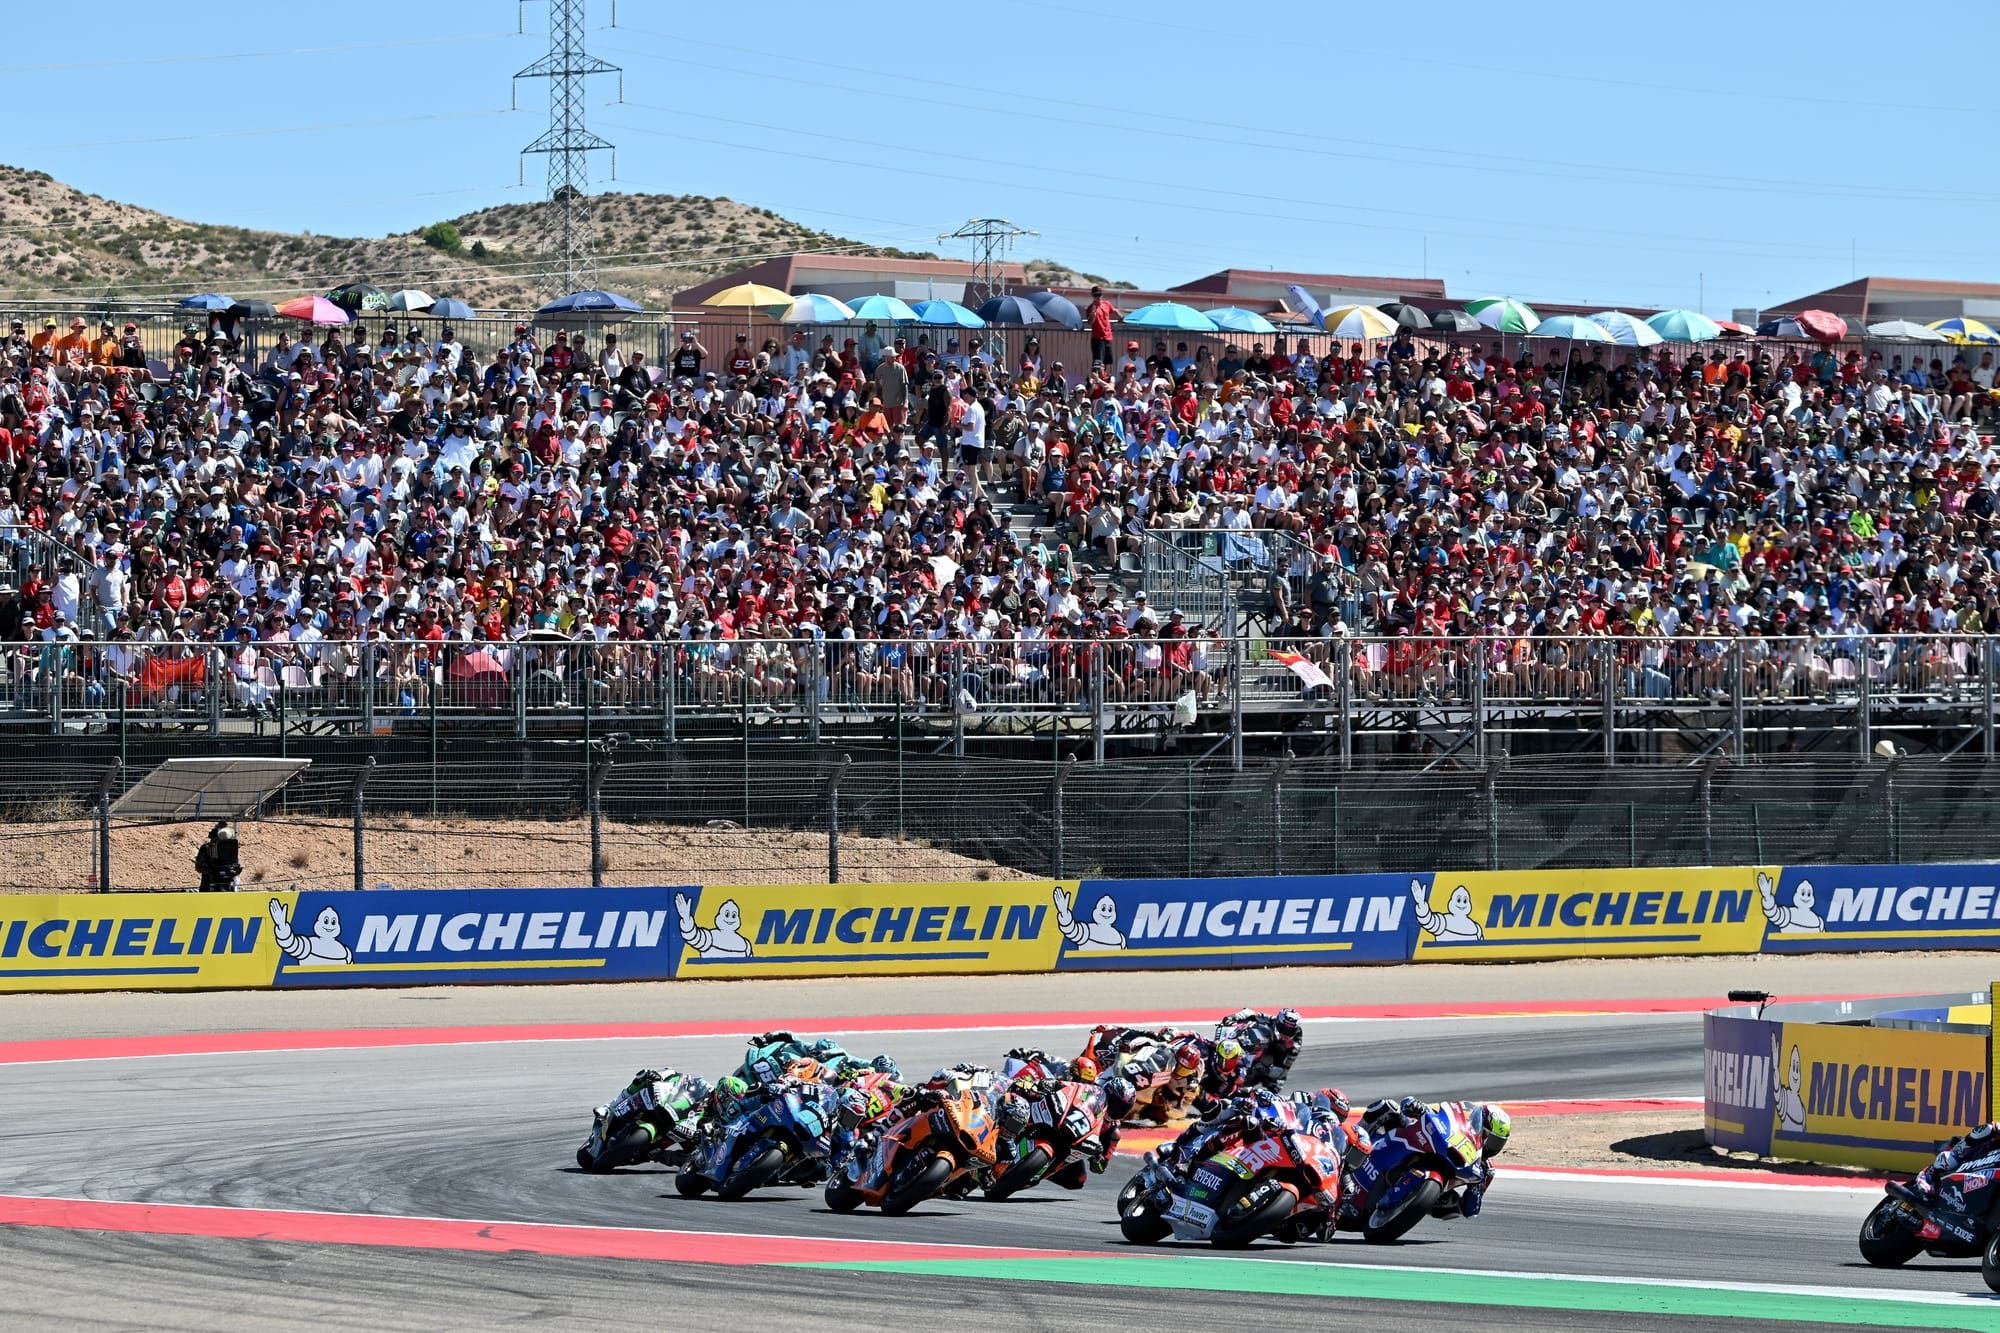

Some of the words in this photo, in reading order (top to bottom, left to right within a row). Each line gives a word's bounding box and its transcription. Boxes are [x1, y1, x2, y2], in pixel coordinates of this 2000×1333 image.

[1130, 896, 1407, 938] MICHELIN
[1486, 891, 1753, 928] MICHELIN
[1827, 886, 2000, 921] MICHE
[0, 917, 262, 957] ICHELIN
[356, 911, 667, 952] MICHELIN
[756, 905, 1047, 944] MICHELIN
[1124, 1062, 1150, 1088] 64
[1808, 1062, 1985, 1128] MICHELIN
[1066, 1110, 1091, 1136] 13
[1447, 1132, 1477, 1165] 12
[1192, 1167, 1223, 1191] REVERTE
[1953, 1226, 1976, 1243] EXIDE
